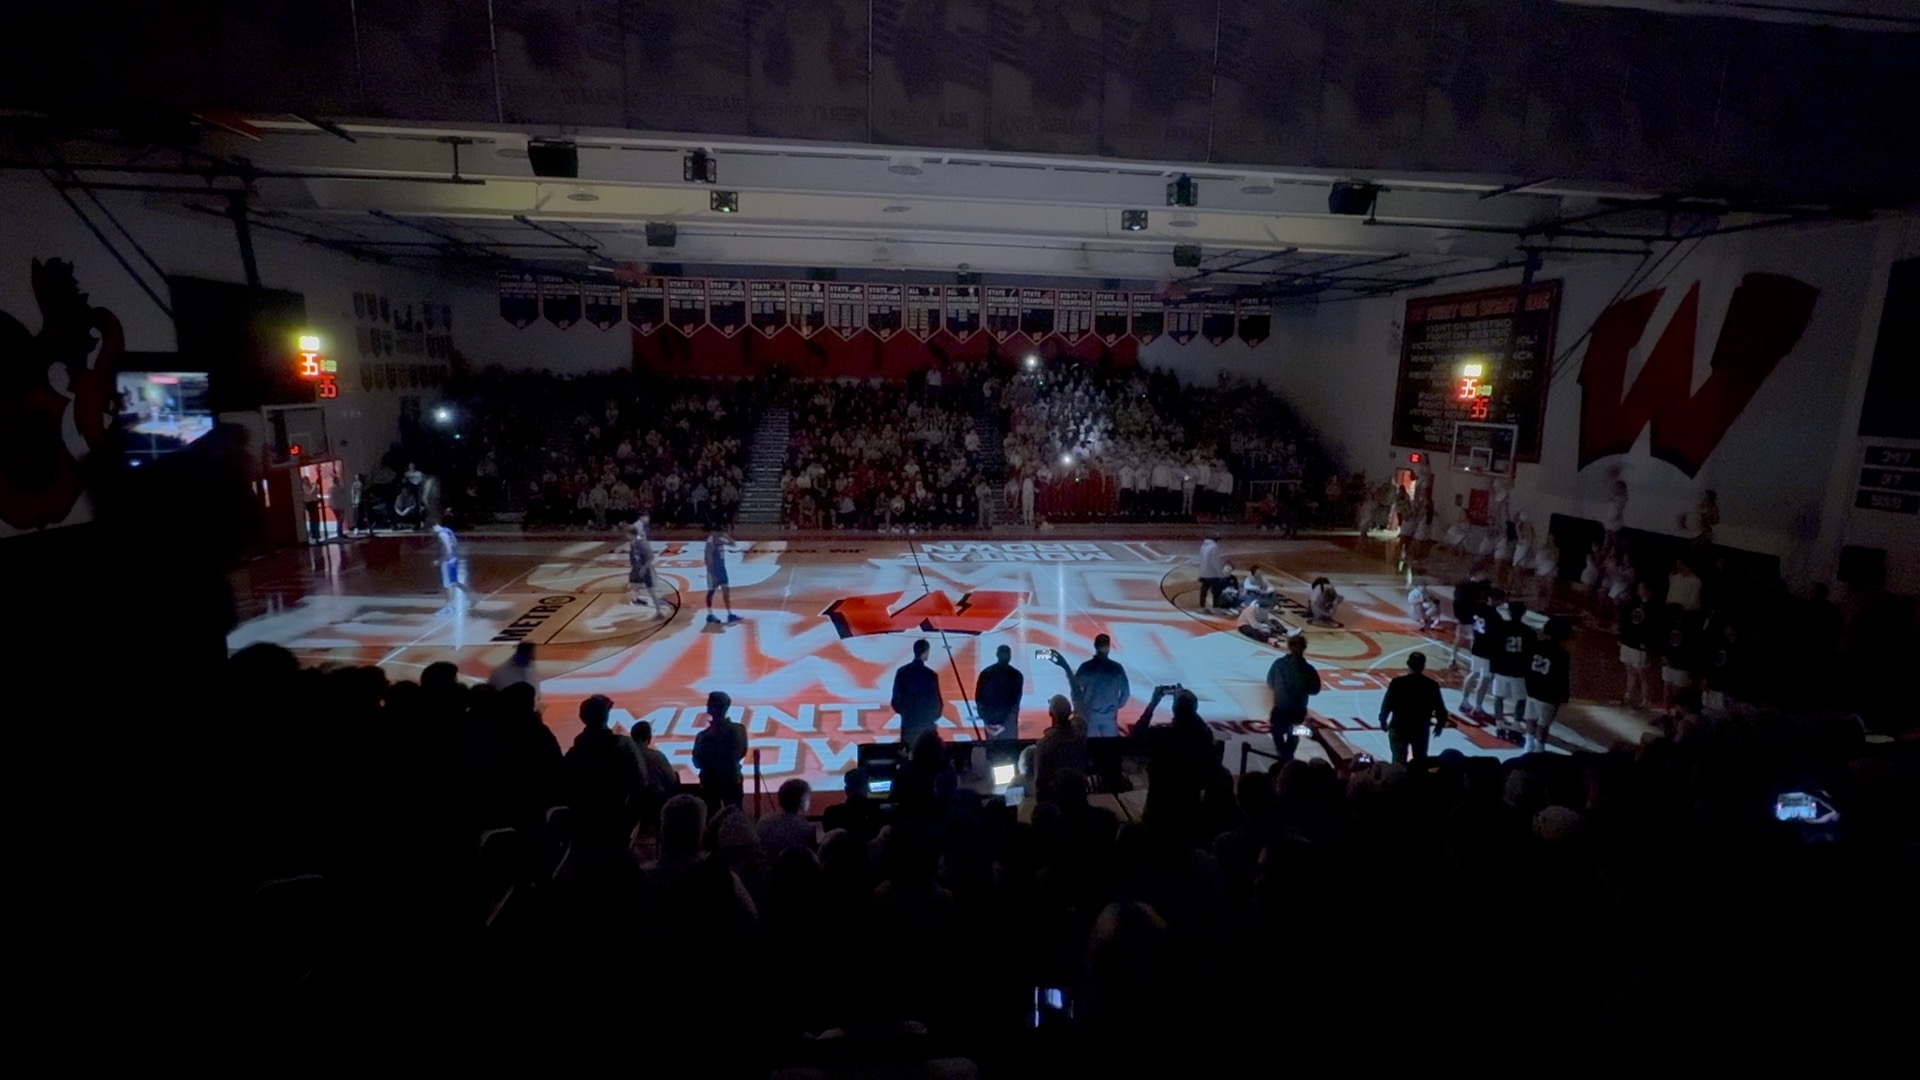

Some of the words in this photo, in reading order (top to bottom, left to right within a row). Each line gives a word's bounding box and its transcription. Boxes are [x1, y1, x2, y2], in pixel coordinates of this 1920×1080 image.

[301, 353, 318, 376] 35
[1460, 379, 1477, 398] 35
[493, 595, 576, 642] METRO
[1505, 636, 1523, 653] 21
[1531, 654, 1551, 676] 23
